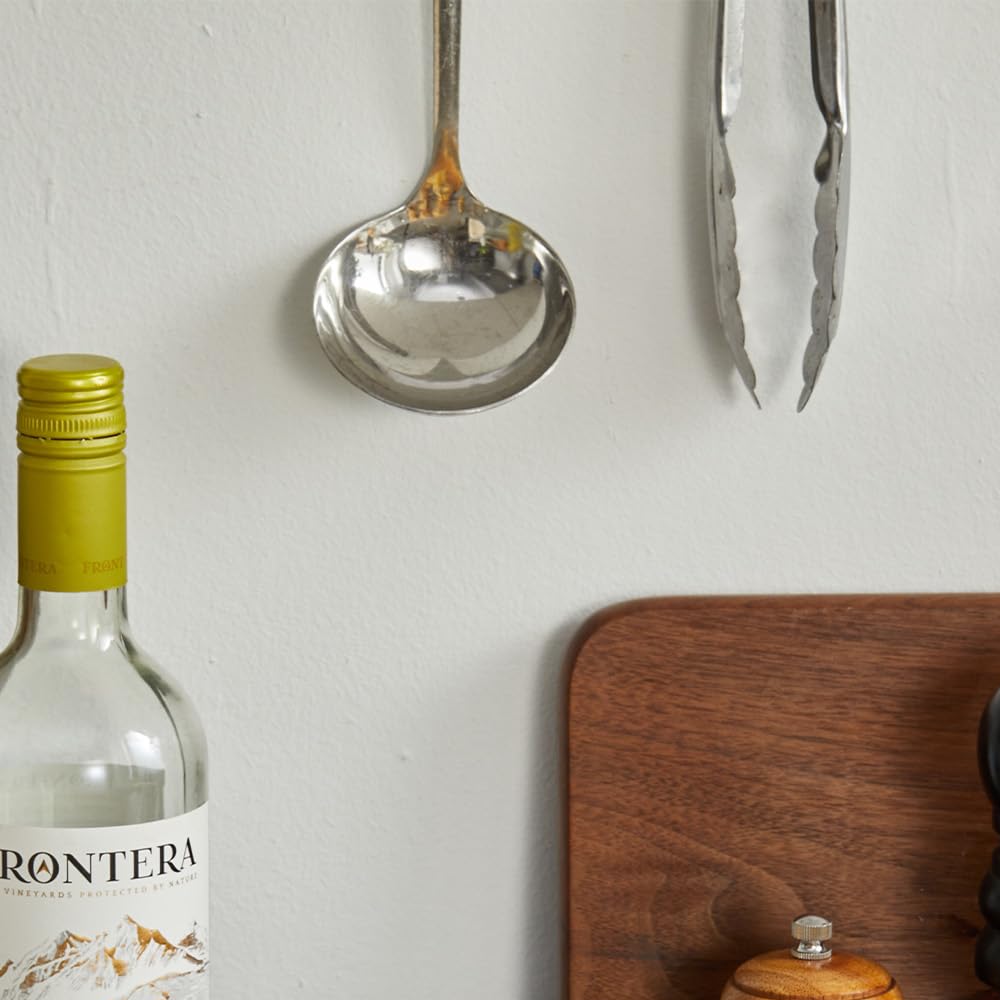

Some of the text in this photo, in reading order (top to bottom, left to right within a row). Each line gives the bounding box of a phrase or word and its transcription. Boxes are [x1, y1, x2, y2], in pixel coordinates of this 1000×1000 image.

[0, 837, 197, 884] RONTERA
[3, 887, 73, 898] VINEYARDS
[80, 886, 148, 898] PROTECTED
